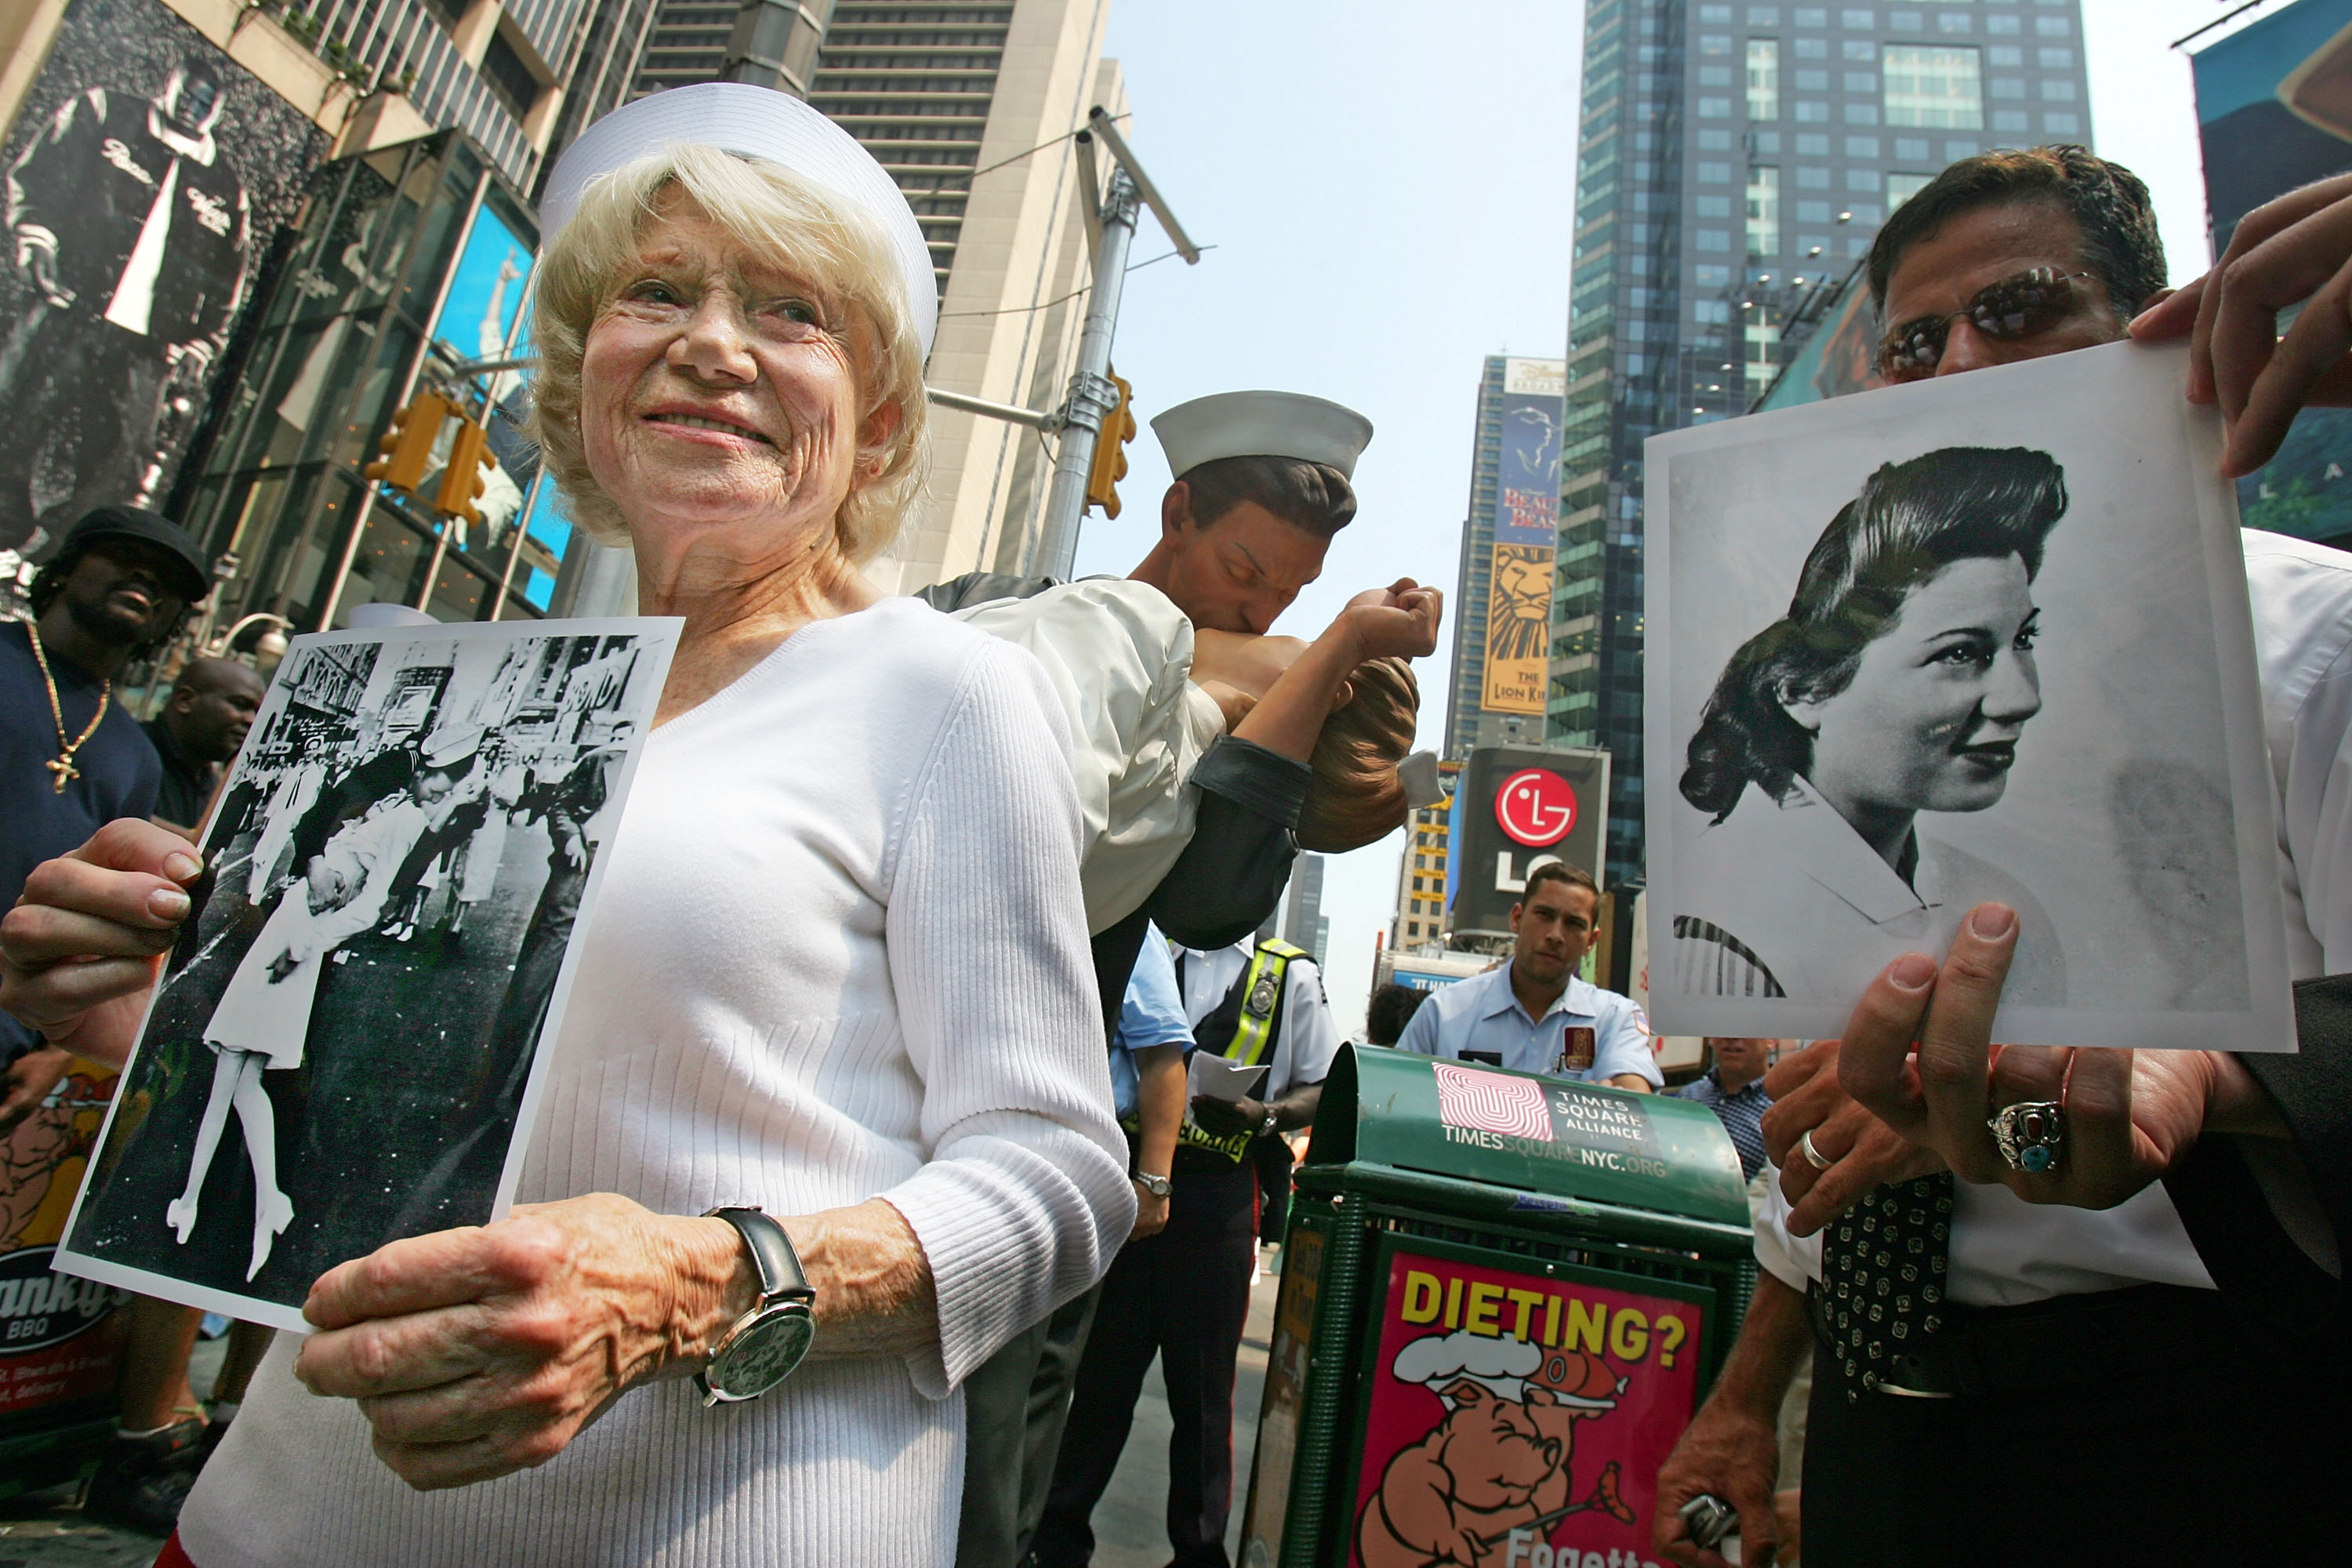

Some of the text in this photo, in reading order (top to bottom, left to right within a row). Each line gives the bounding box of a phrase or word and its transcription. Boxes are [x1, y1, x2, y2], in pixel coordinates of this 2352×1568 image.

[1518, 672, 1540, 684] THE
[1557, 1091, 1628, 1112] TIMES
[1555, 1102, 1643, 1127] SQUARE
[1566, 1118, 1643, 1141] ALLIANCE
[1401, 1270, 1686, 1367] DIETING?
